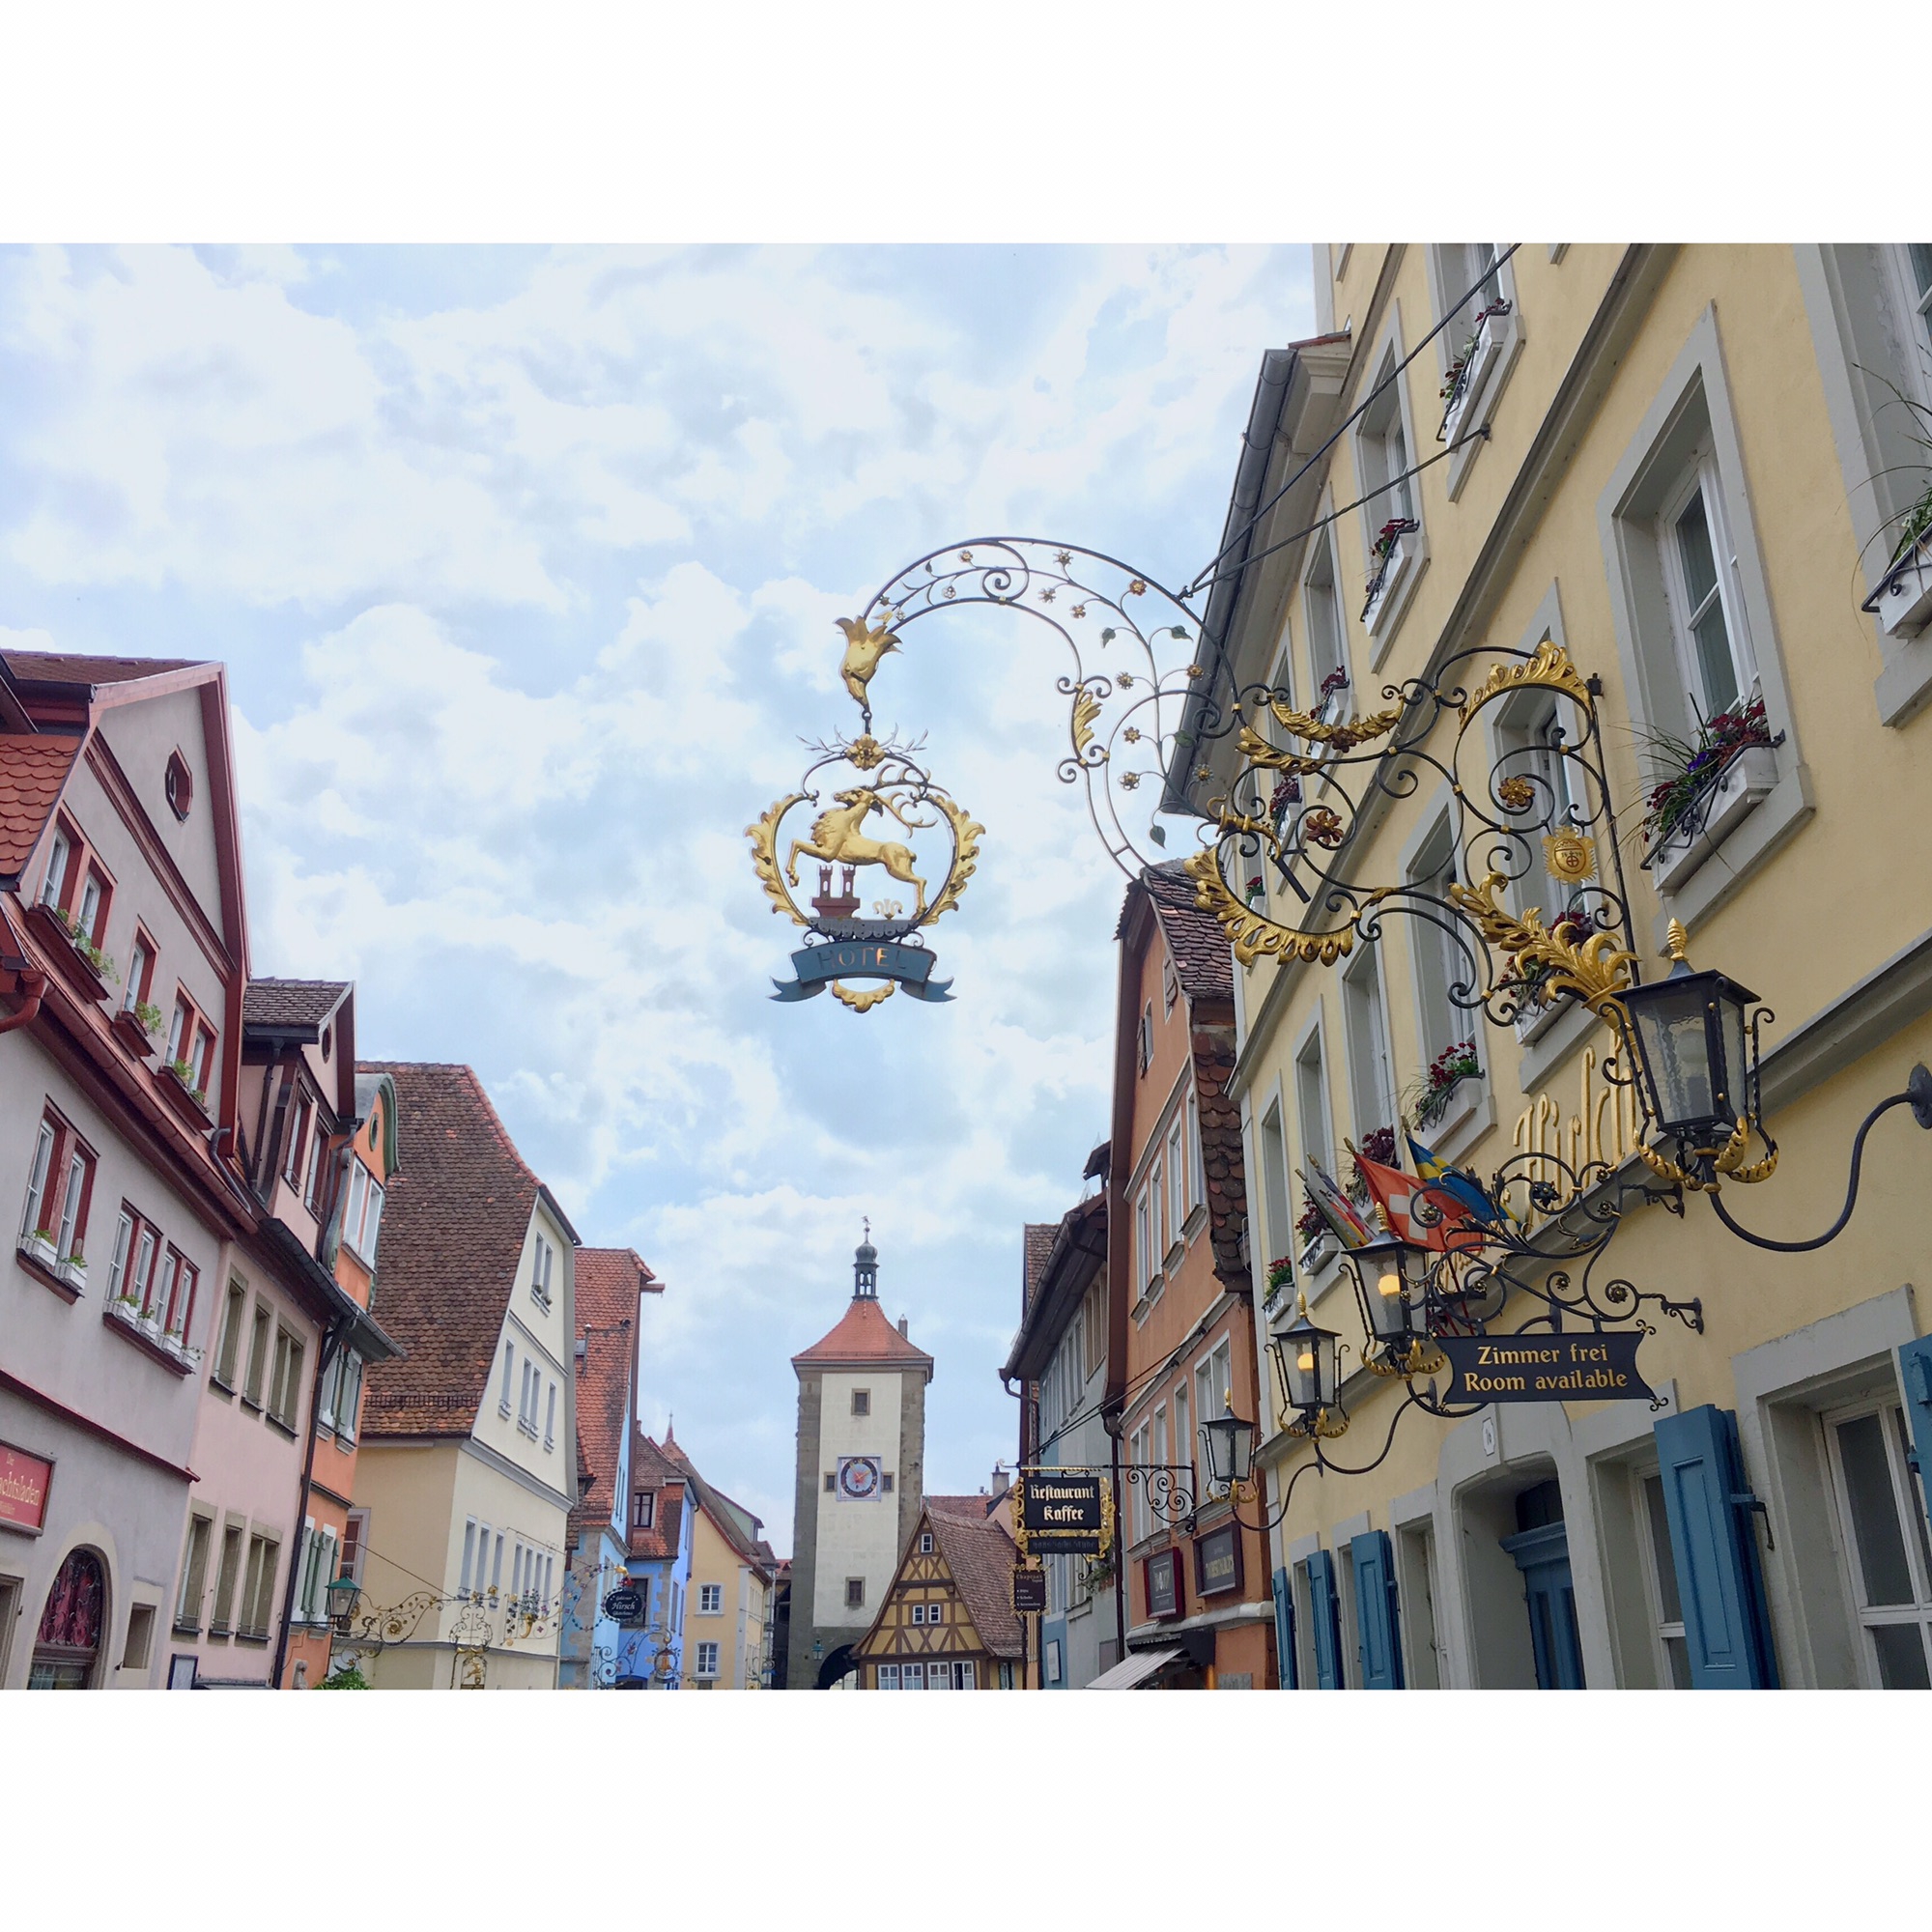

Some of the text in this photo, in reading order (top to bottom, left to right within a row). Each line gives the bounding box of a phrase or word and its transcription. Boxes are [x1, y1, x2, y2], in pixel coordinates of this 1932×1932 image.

[816, 946, 907, 971] HOTEL
[1477, 1343, 1608, 1365] Zimmer frei
[1463, 1369, 1628, 1392] Room available
[1043, 1505, 1084, 1521] Kaffee
[611, 1601, 636, 1610] Hirsch
